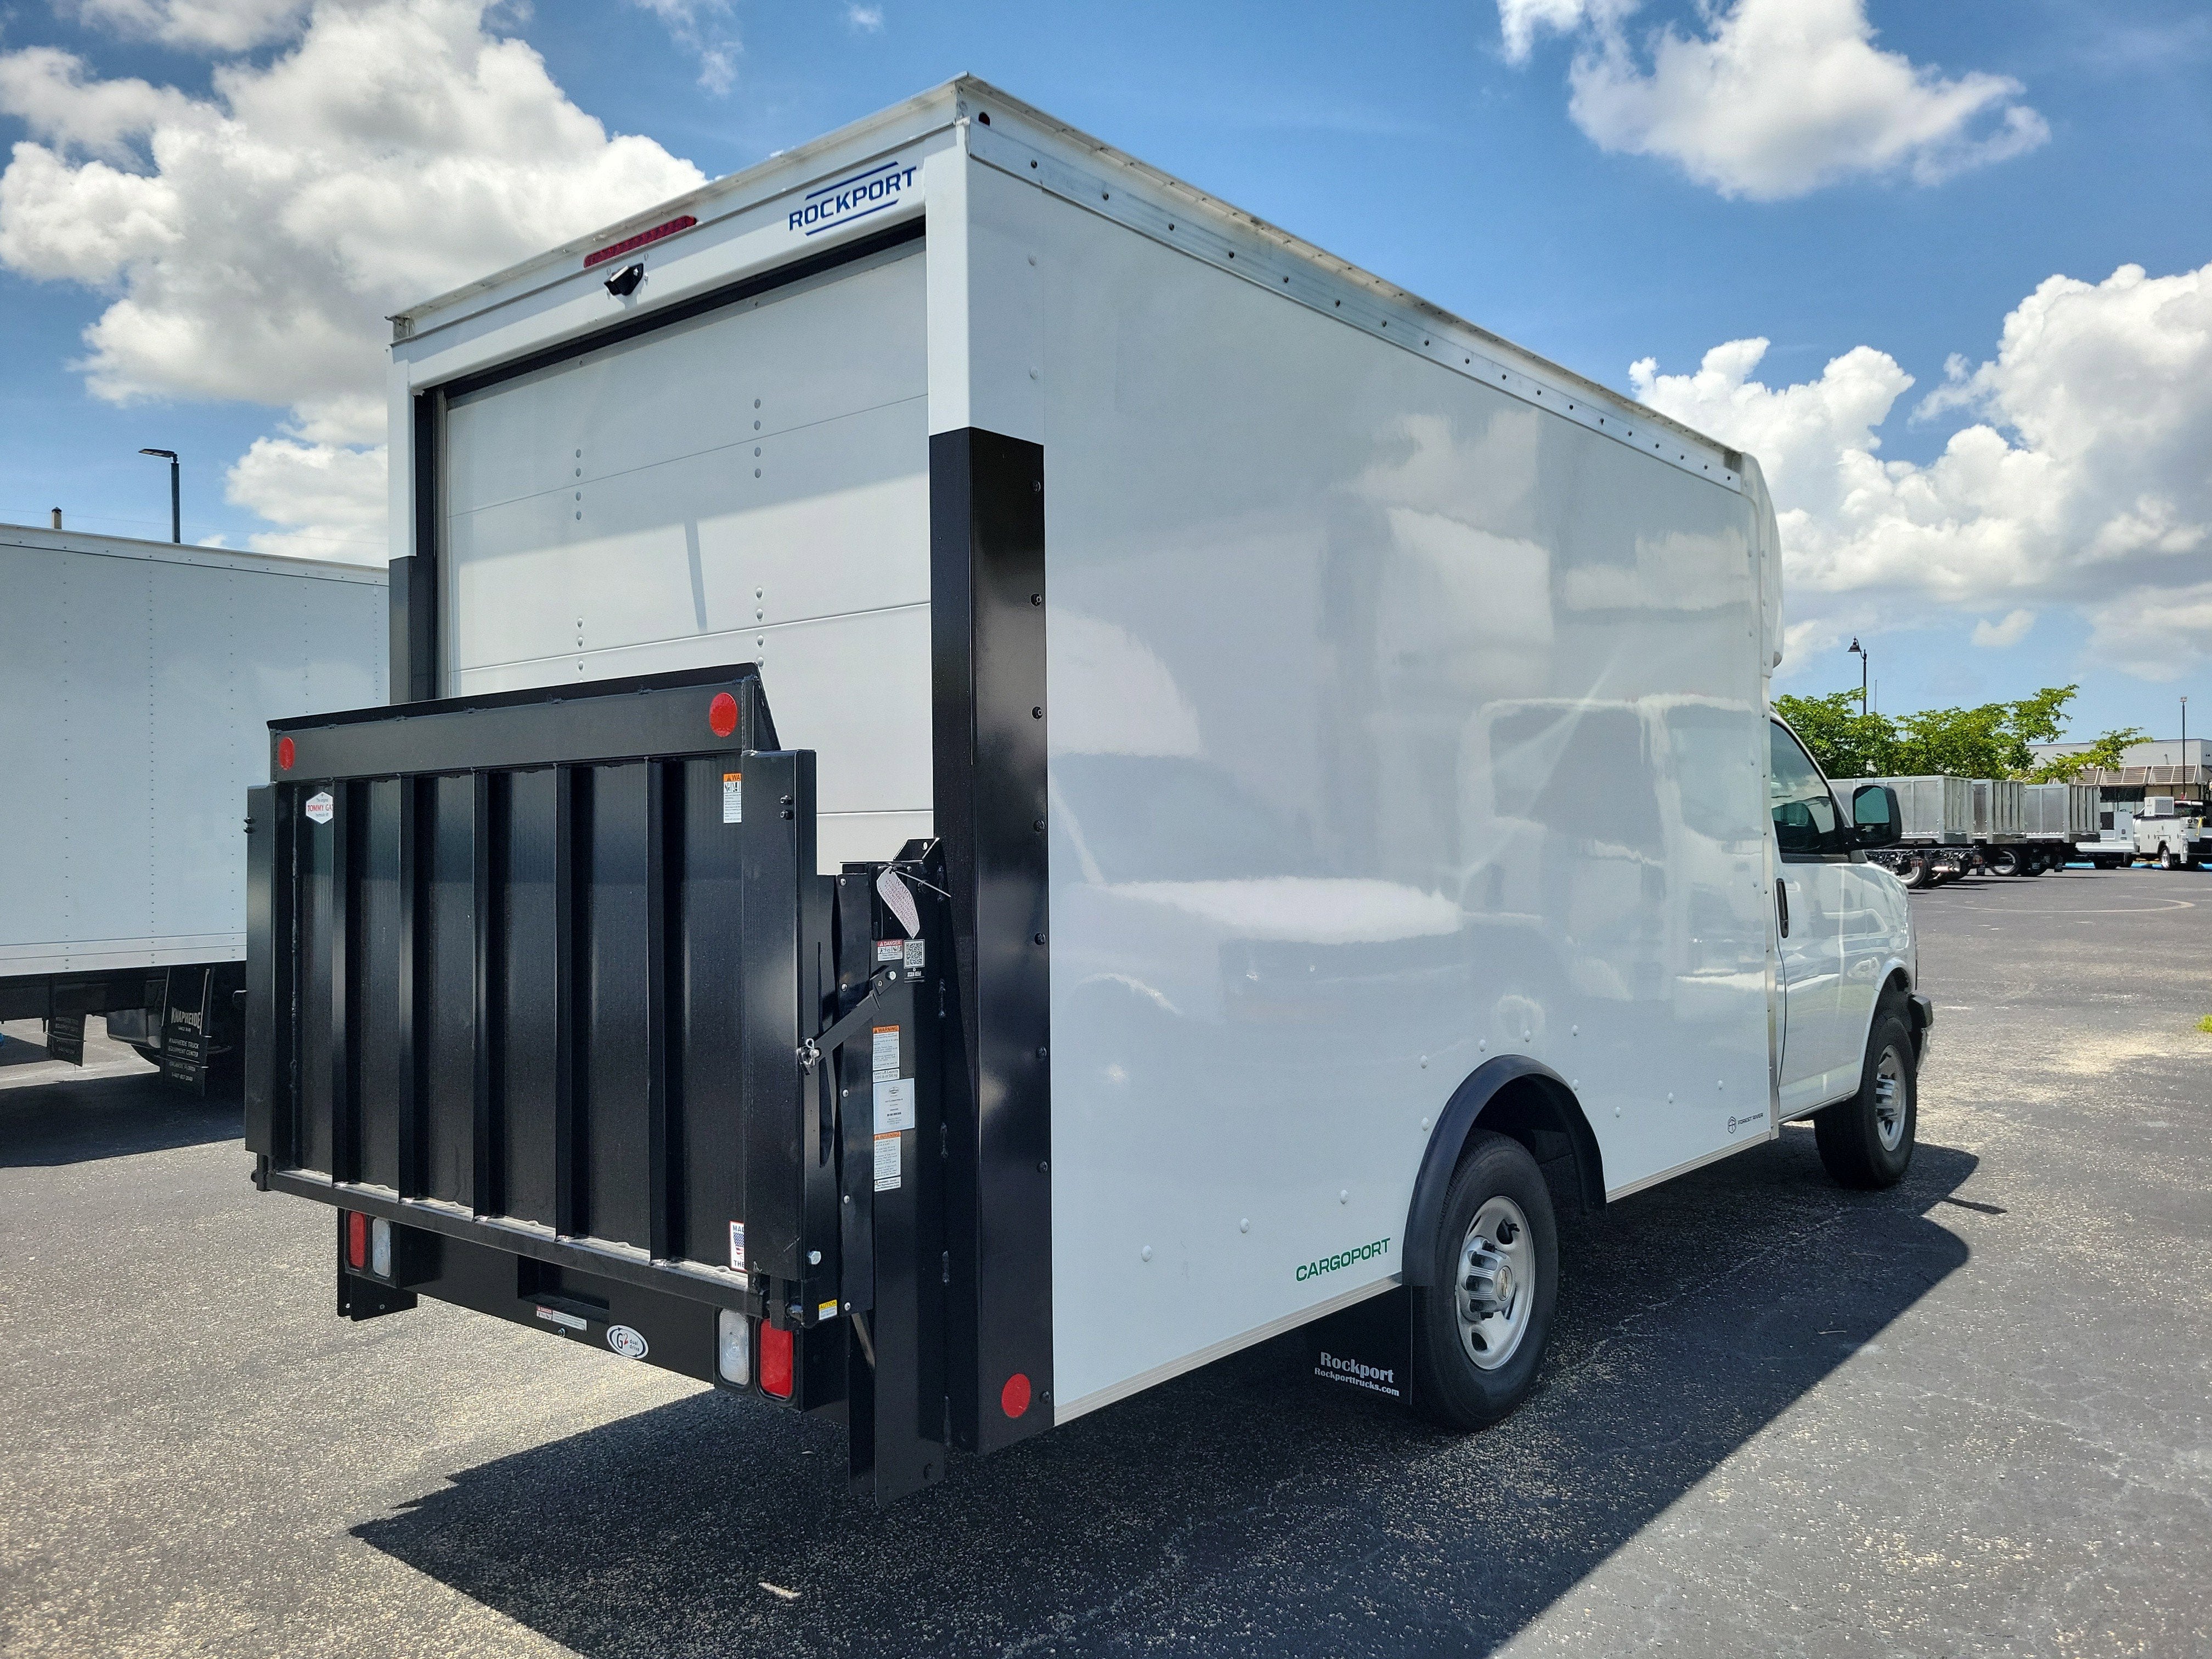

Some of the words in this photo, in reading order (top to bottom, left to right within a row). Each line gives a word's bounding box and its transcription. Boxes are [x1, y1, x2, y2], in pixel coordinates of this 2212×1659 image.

[789, 166, 917, 231] ROCKPORT
[896, 879, 914, 904] WARNI
[171, 1007, 201, 1029] KNAPHEIDE
[188, 1041, 199, 1049] TRUCK
[1296, 1237, 1391, 1282] CARGOPORT
[1314, 1367, 1400, 1396] Rockporttrucks.com
[1321, 1351, 1394, 1383] Rockport
